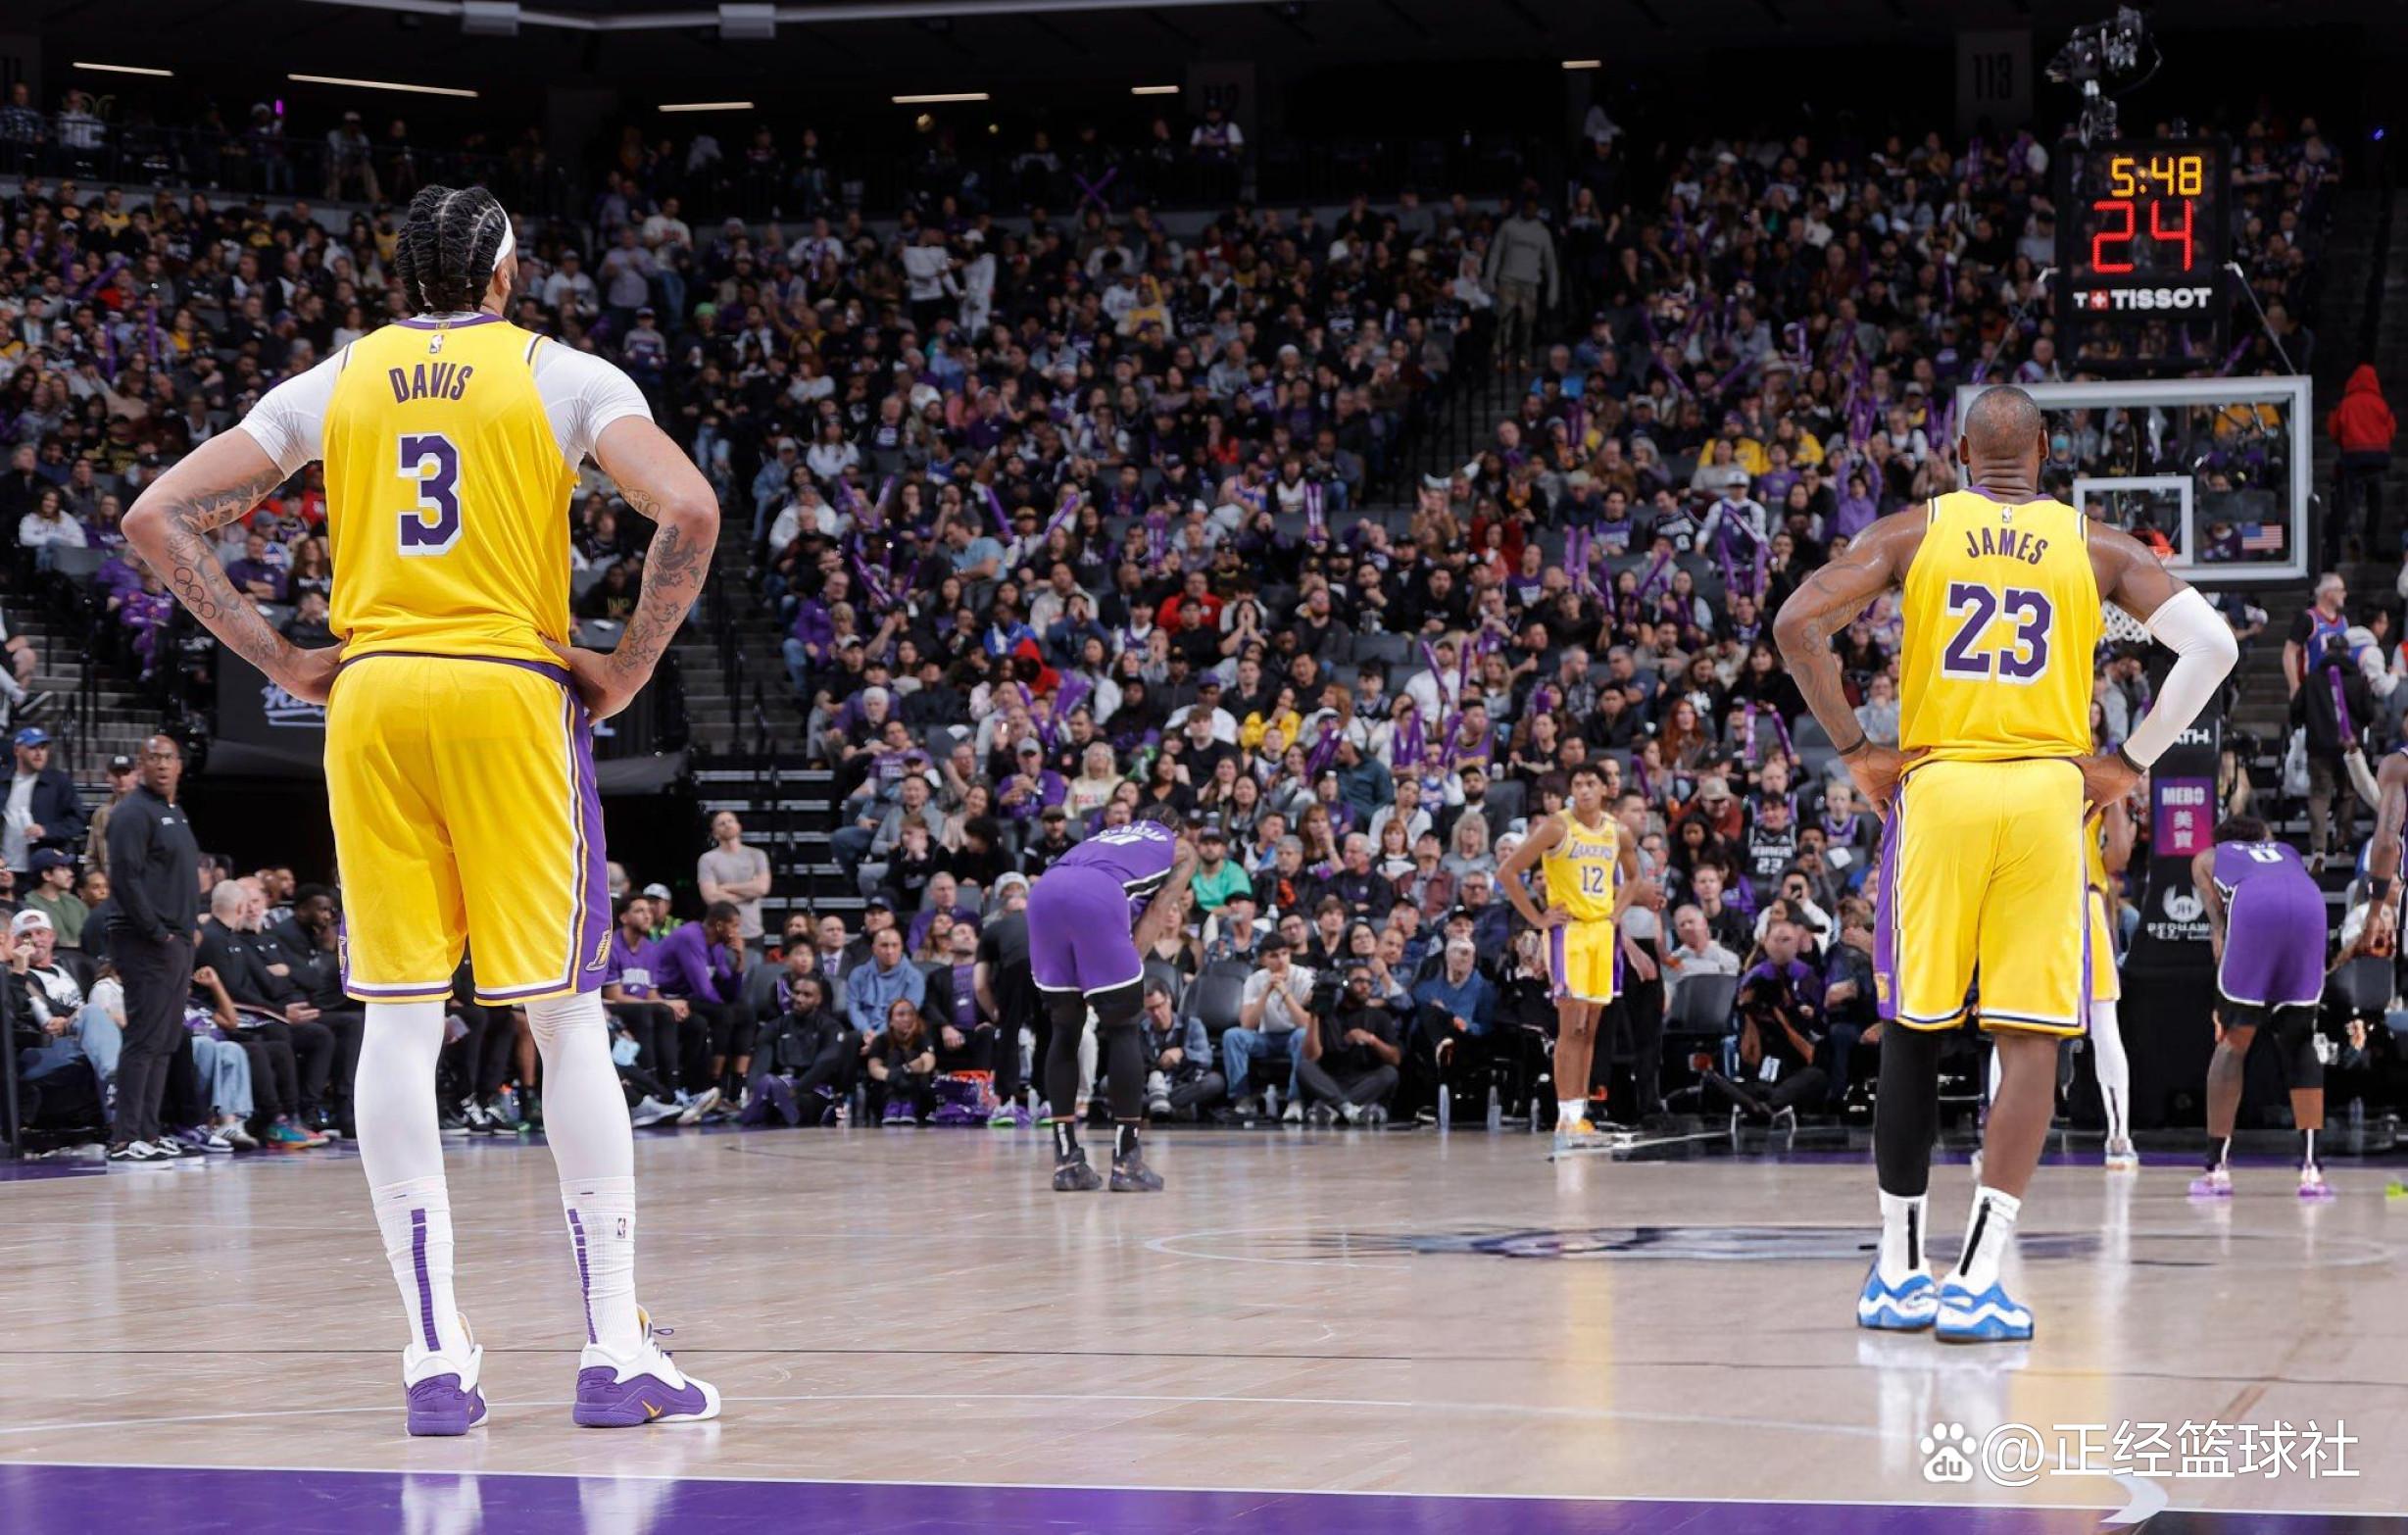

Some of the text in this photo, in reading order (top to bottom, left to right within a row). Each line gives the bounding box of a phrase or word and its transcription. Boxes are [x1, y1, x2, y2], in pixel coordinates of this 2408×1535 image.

[1973, 52, 2014, 102] 113
[2111, 156, 2202, 196] 5:48
[2091, 199, 2193, 273] 24
[2110, 286, 2212, 310] TISSOT
[388, 362, 473, 404] DAVIS
[397, 431, 464, 557] 3
[1965, 526, 2049, 566] JAMES
[1941, 580, 2055, 685] 23
[2161, 786, 2205, 806] MEBO
[1582, 865, 1605, 894] 12
